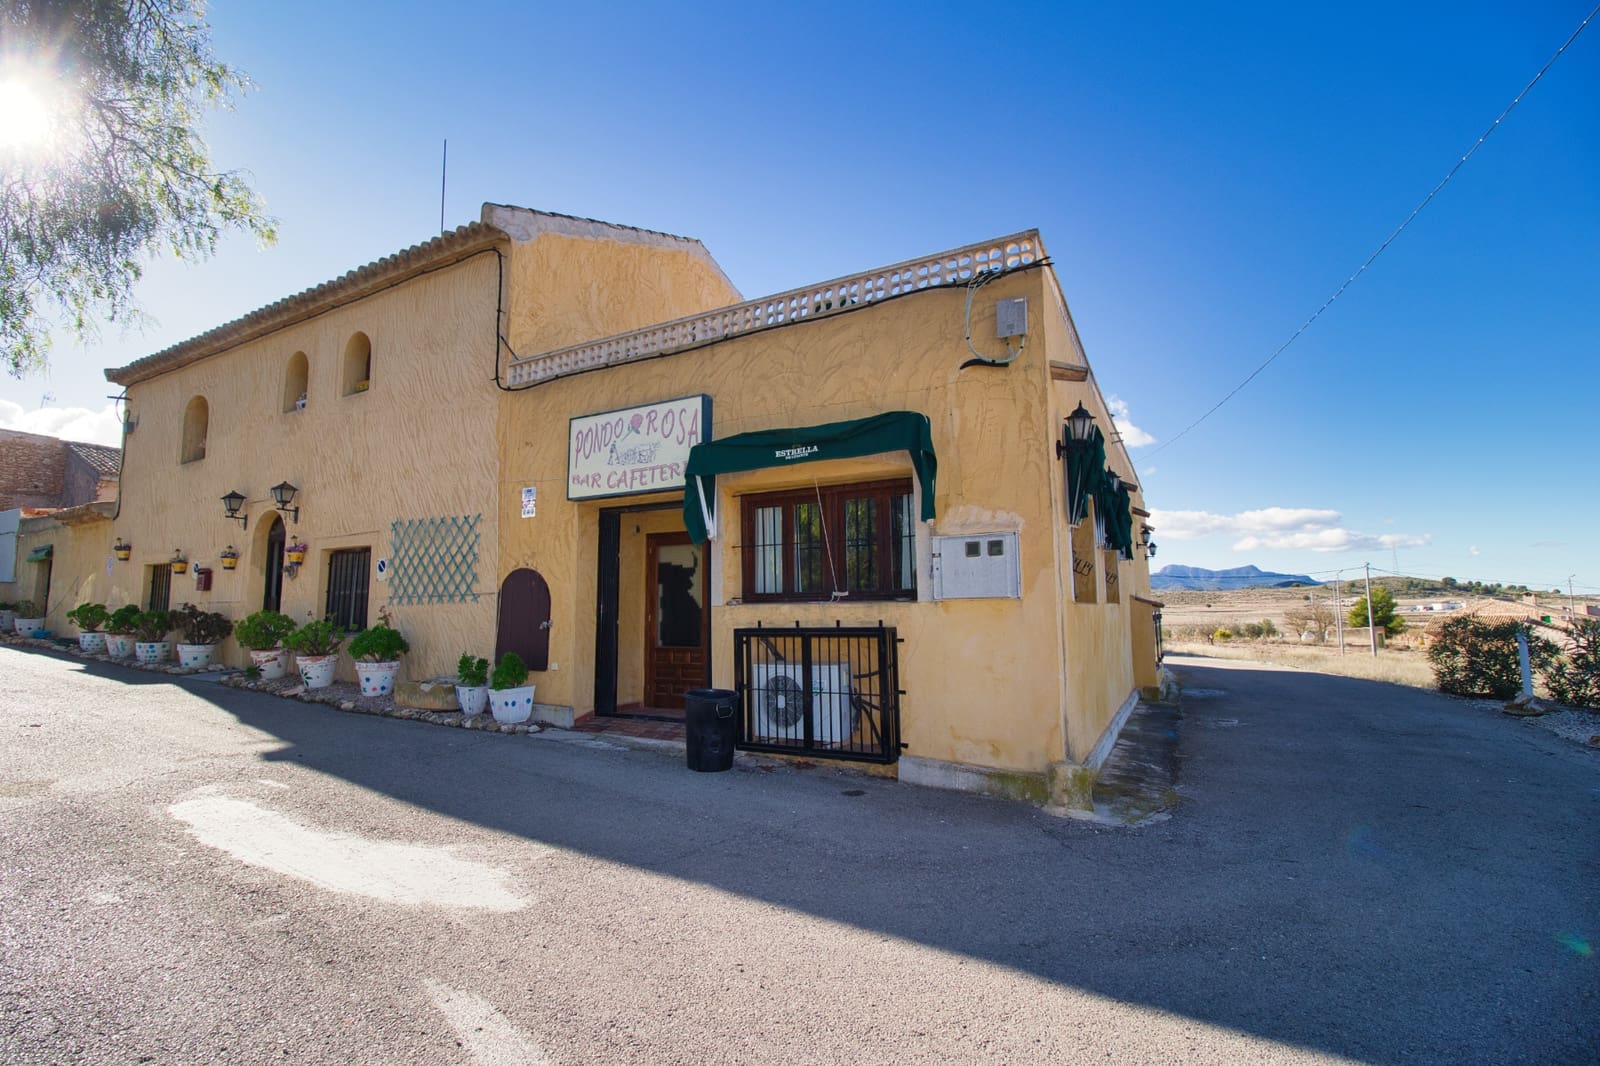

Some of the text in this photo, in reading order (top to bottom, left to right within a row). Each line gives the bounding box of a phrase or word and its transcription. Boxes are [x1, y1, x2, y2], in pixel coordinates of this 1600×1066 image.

[575, 407, 699, 469] PONDO ROSA
[775, 445, 818, 458] ESTRELLA
[572, 472, 602, 489] BAR
